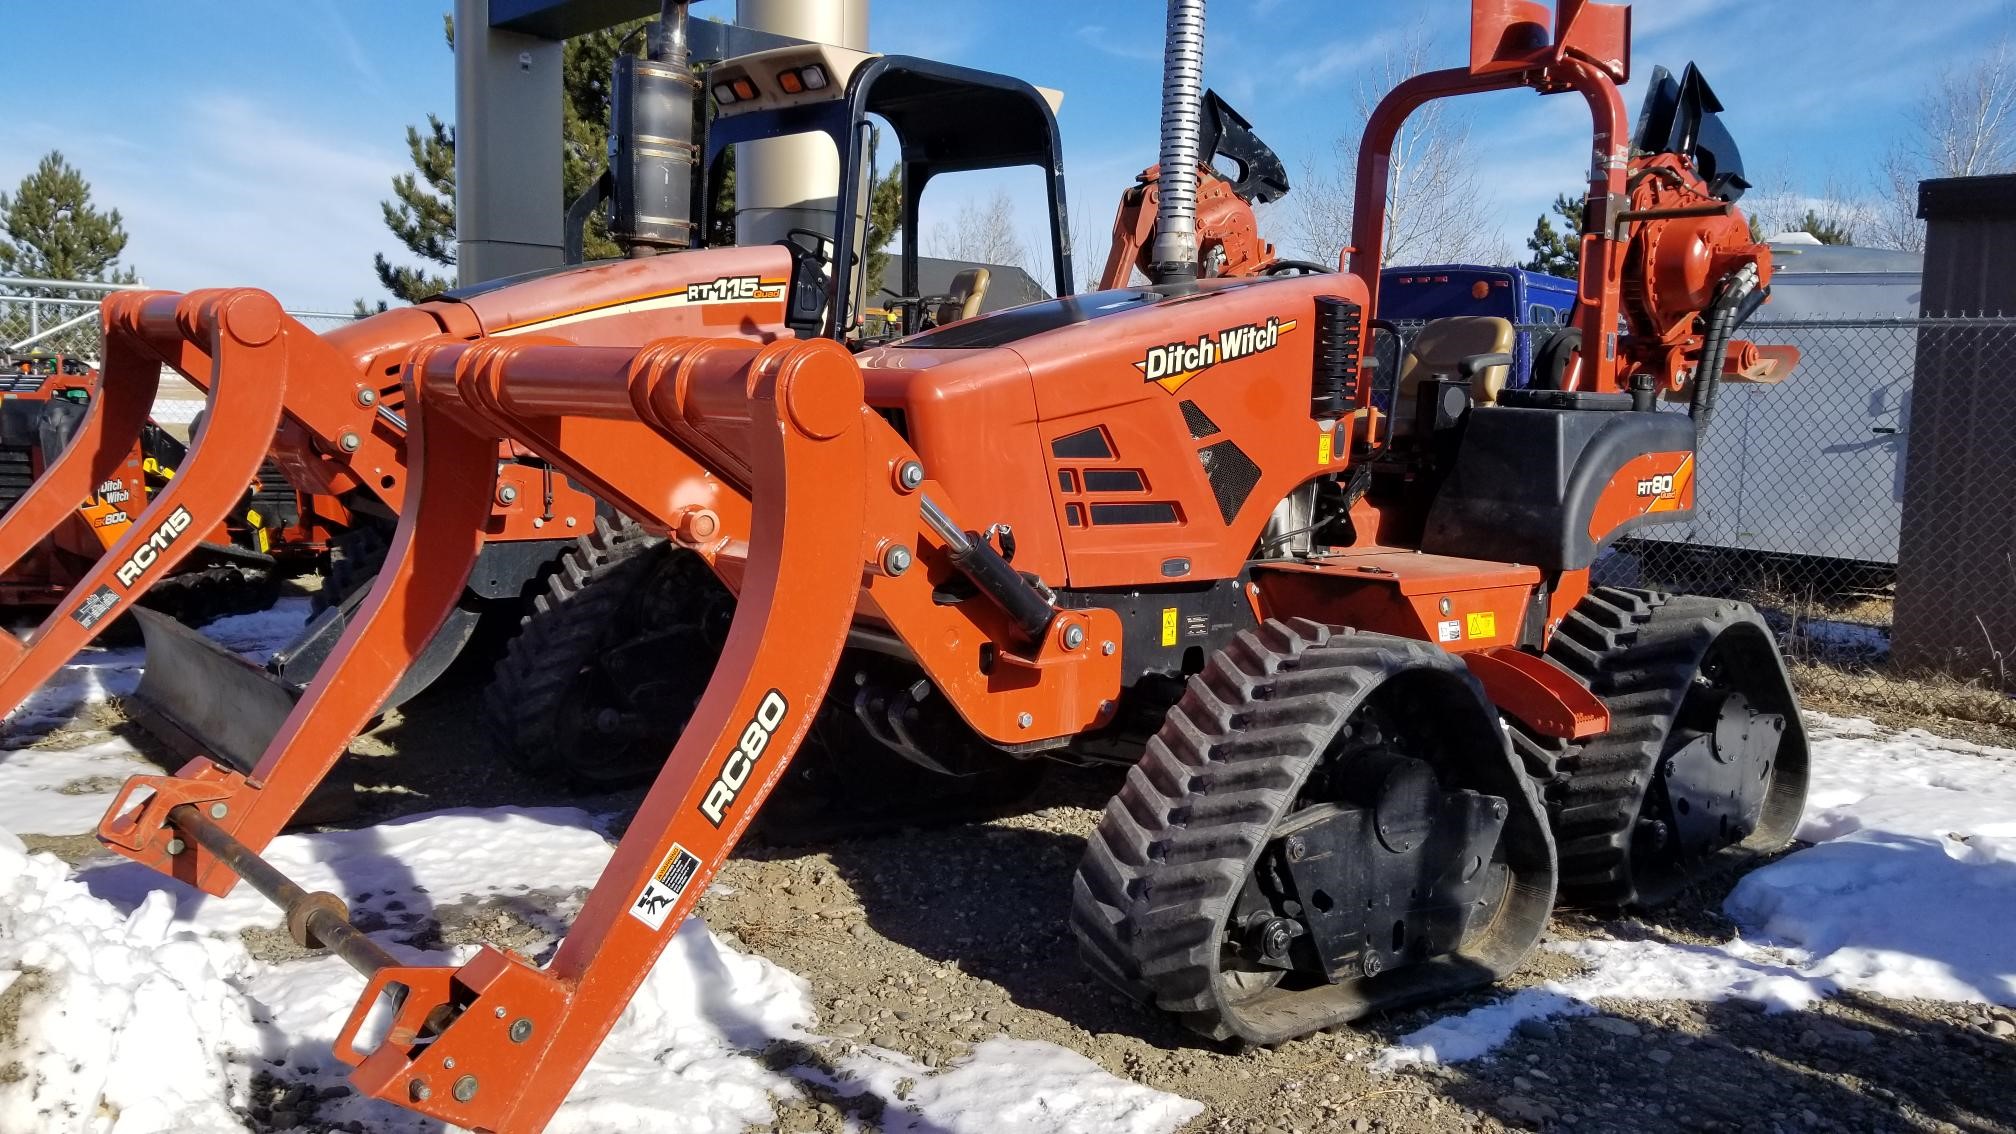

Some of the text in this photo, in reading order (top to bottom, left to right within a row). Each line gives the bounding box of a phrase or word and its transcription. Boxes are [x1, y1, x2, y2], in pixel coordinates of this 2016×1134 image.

[687, 276, 780, 301] RT115 Quad
[1145, 317, 1278, 381] Ditch Witch
[106, 489, 129, 504] Witch
[1637, 474, 1673, 496] RT80
[114, 504, 192, 589] RC115
[699, 689, 788, 828] RC80
